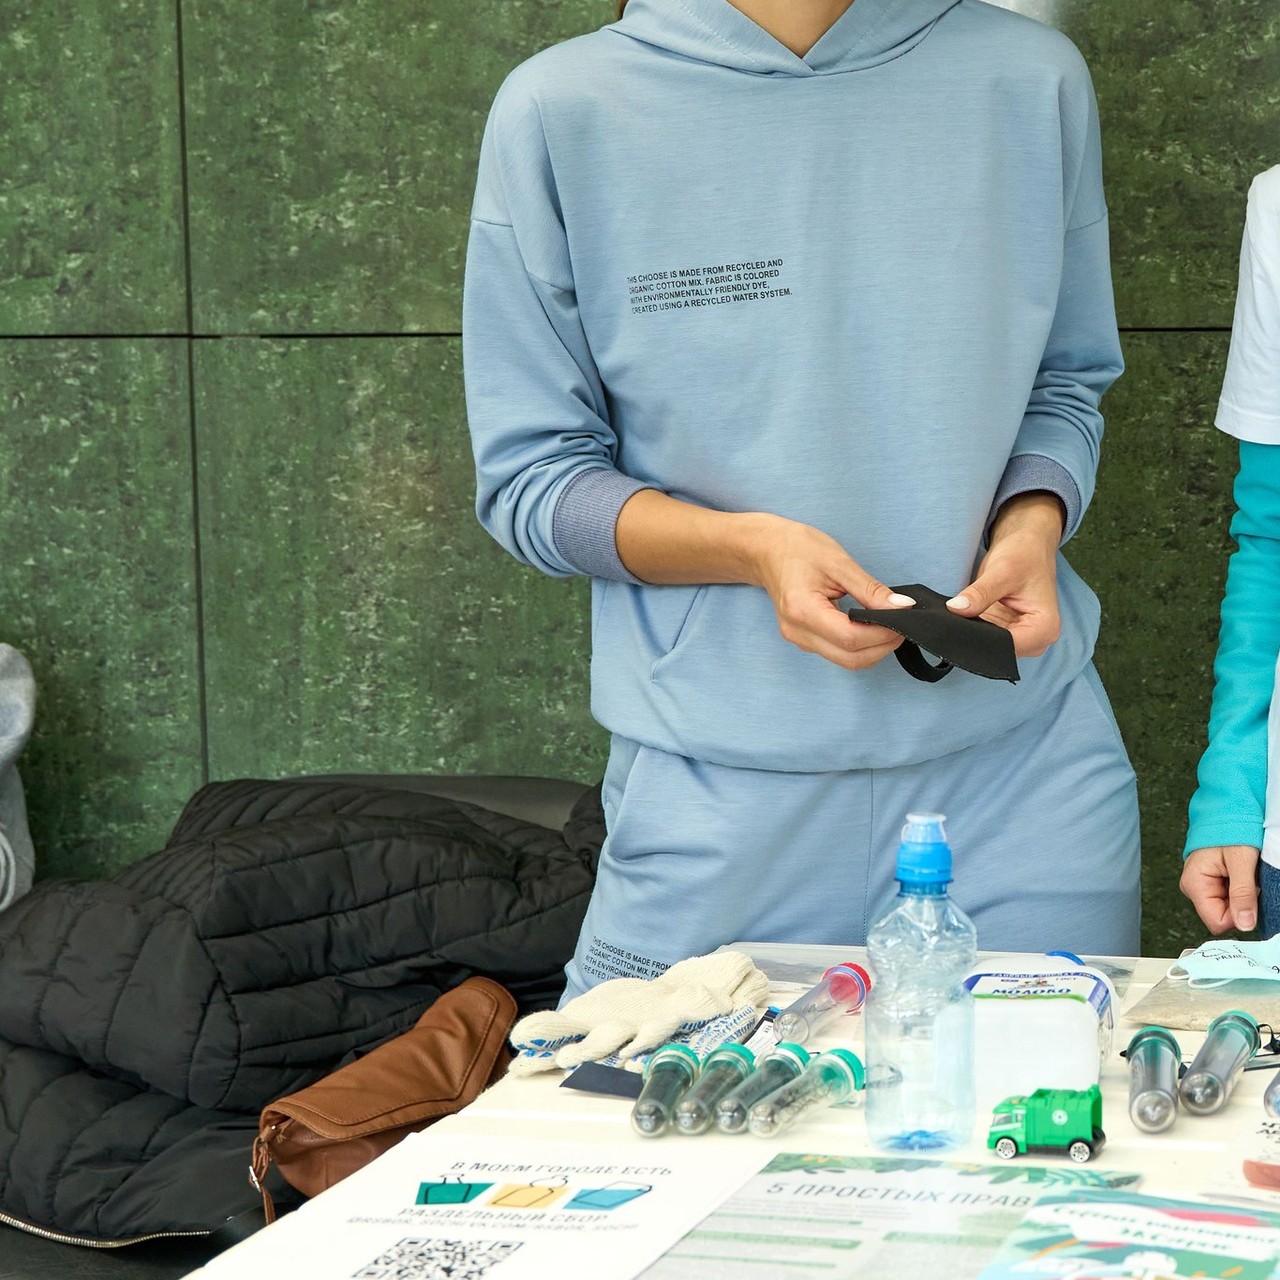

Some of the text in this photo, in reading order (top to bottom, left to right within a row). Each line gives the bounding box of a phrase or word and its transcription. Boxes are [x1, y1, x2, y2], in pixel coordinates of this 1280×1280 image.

[627, 258, 783, 284] THIS CHOOSE IS MADE FROM RECYCLED AND
[629, 269, 780, 294] ORGANIC COTTON MIX. FABRIC IS COLORED
[630, 280, 770, 304] WITH ENVIRONMENTALLY FRIENDLY DYE,
[631, 287, 793, 314] CREATED USING A RECYCLED WATER SYSTEM.
[588, 945, 611, 961] ORGANIC
[611, 957, 636, 971] COTTON
[601, 942, 625, 957] CHOOSE
[625, 952, 632, 960] IS
[632, 955, 650, 967] MADE
[581, 963, 607, 980] CREATED
[450, 1161, 672, 1175] В МОЕМ ГОРОДЕ ЕСТЬ
[766, 1182, 790, 1194] 5
[793, 1183, 946, 1203] ПРОСТЫХ
[398, 1207, 608, 1222] РАЗДЕЛЬНЫЙ СБОР
